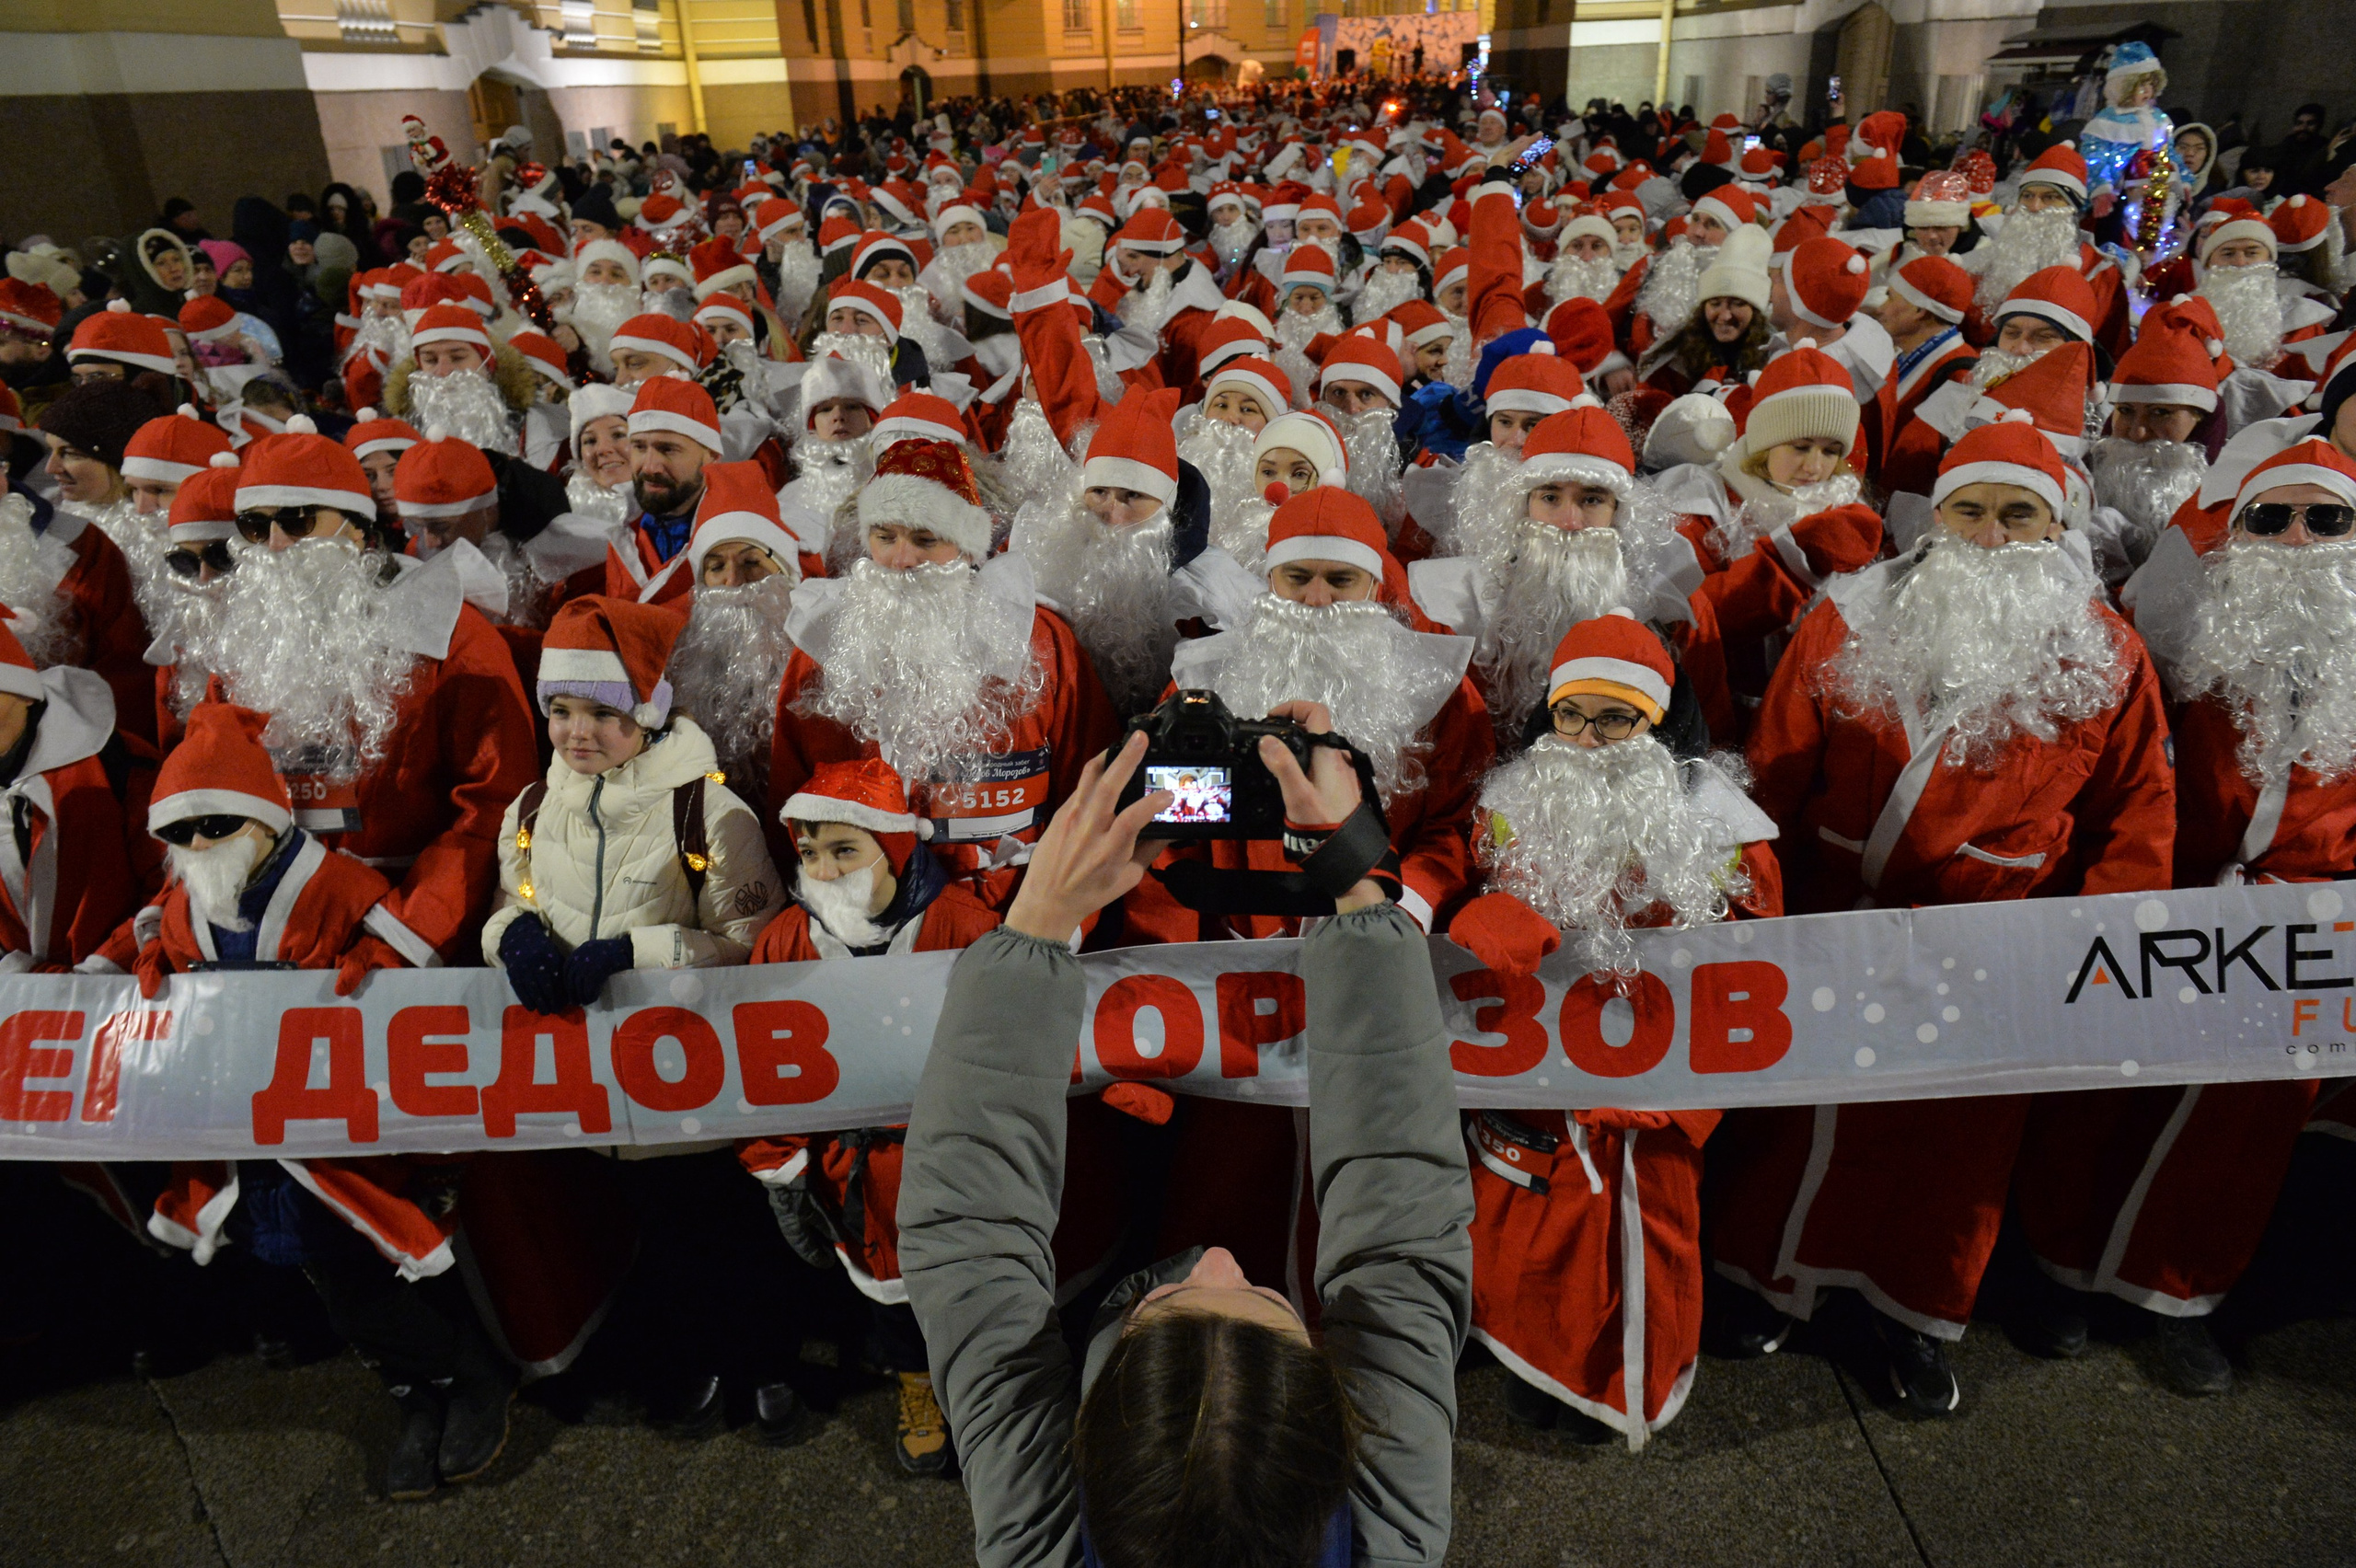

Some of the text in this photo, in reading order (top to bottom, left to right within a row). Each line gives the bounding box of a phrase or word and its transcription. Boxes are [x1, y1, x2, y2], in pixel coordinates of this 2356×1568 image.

[963, 788, 1025, 809] 5152
[251, 998, 840, 1146] ДЕДОВ
[1069, 960, 1794, 1086] ОРЗОВ
[2285, 1042, 2356, 1055] com
